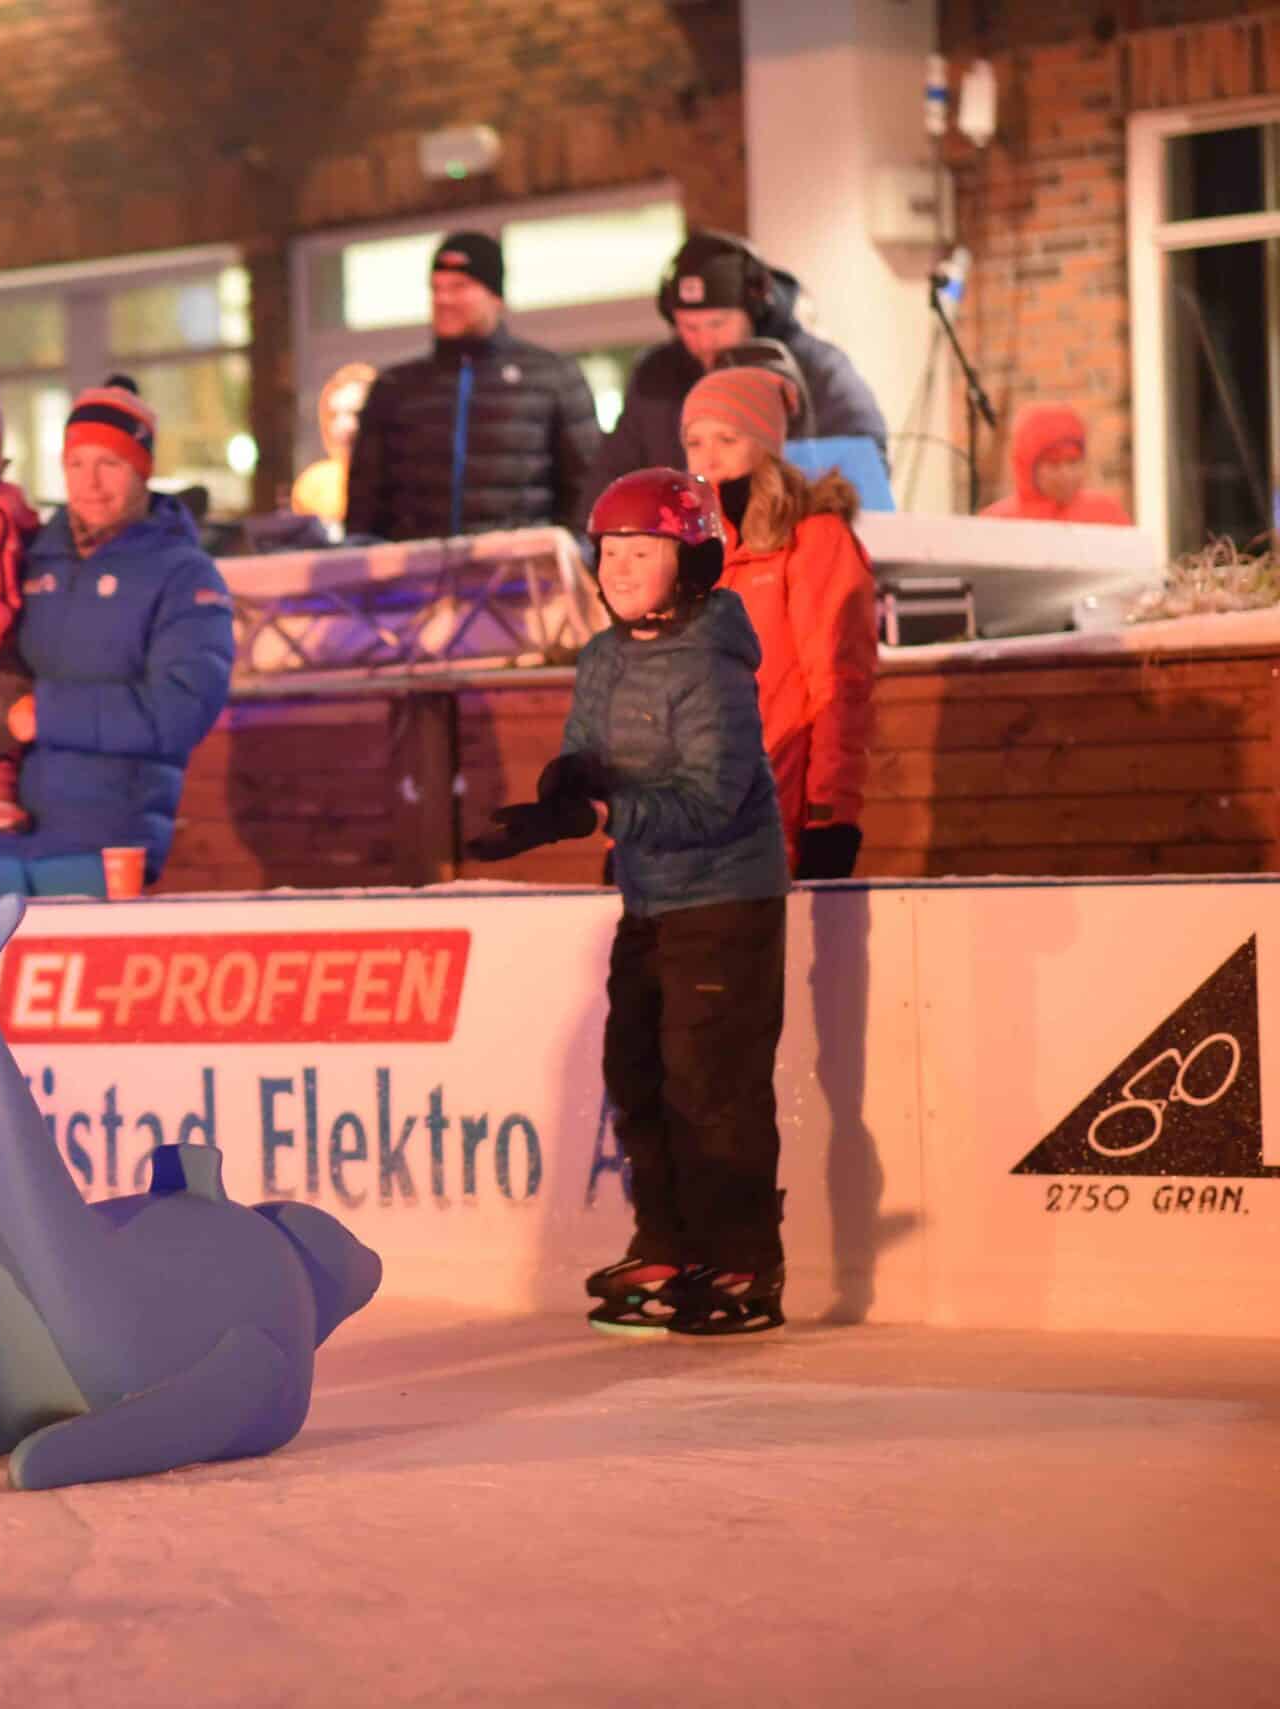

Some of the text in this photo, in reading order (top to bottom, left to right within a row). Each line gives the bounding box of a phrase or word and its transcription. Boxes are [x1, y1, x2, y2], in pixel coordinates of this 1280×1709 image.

[10, 950, 452, 1029] EL-PROFFEN
[259, 1066, 542, 1208] Elektro
[1045, 1184, 1249, 1214] 2750 GRAN.
